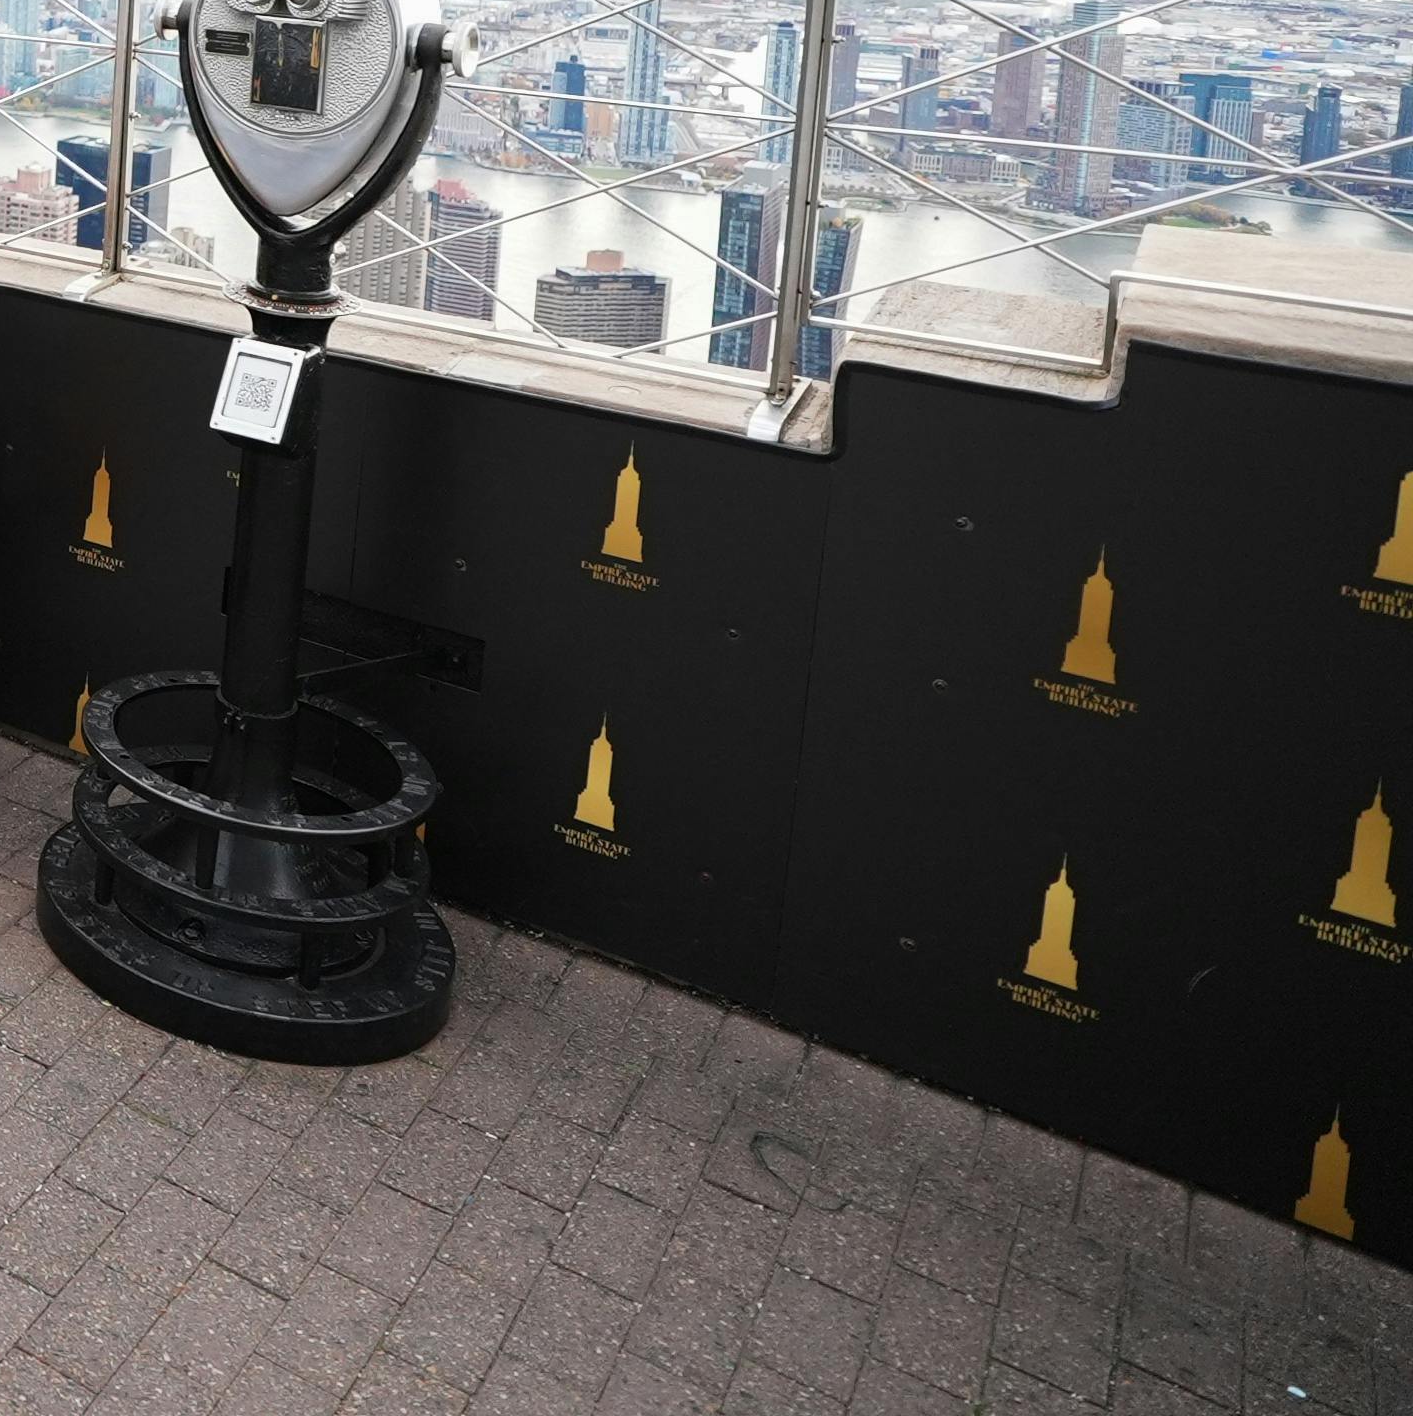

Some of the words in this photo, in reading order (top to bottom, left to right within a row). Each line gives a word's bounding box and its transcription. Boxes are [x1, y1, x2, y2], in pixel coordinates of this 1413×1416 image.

[581, 560, 623, 578] EMPIRE
[625, 572, 659, 587] STATE
[592, 571, 646, 591] BUILDING
[1034, 678, 1089, 700] EMPIRE
[1093, 694, 1137, 712] STATE
[1049, 691, 1119, 717] BUILDING
[554, 823, 595, 844] EMPIRE
[597, 839, 630, 856] STATE
[565, 835, 617, 859] BUILDING
[1298, 914, 1363, 942] EMPIRE
[1368, 935, 1413, 960] STAT
[1316, 929, 1401, 964] BUILDING
[997, 978, 1051, 1004] EMPIRE
[1055, 998, 1099, 1020] STATE
[1012, 992, 1081, 1023] BUILDING
